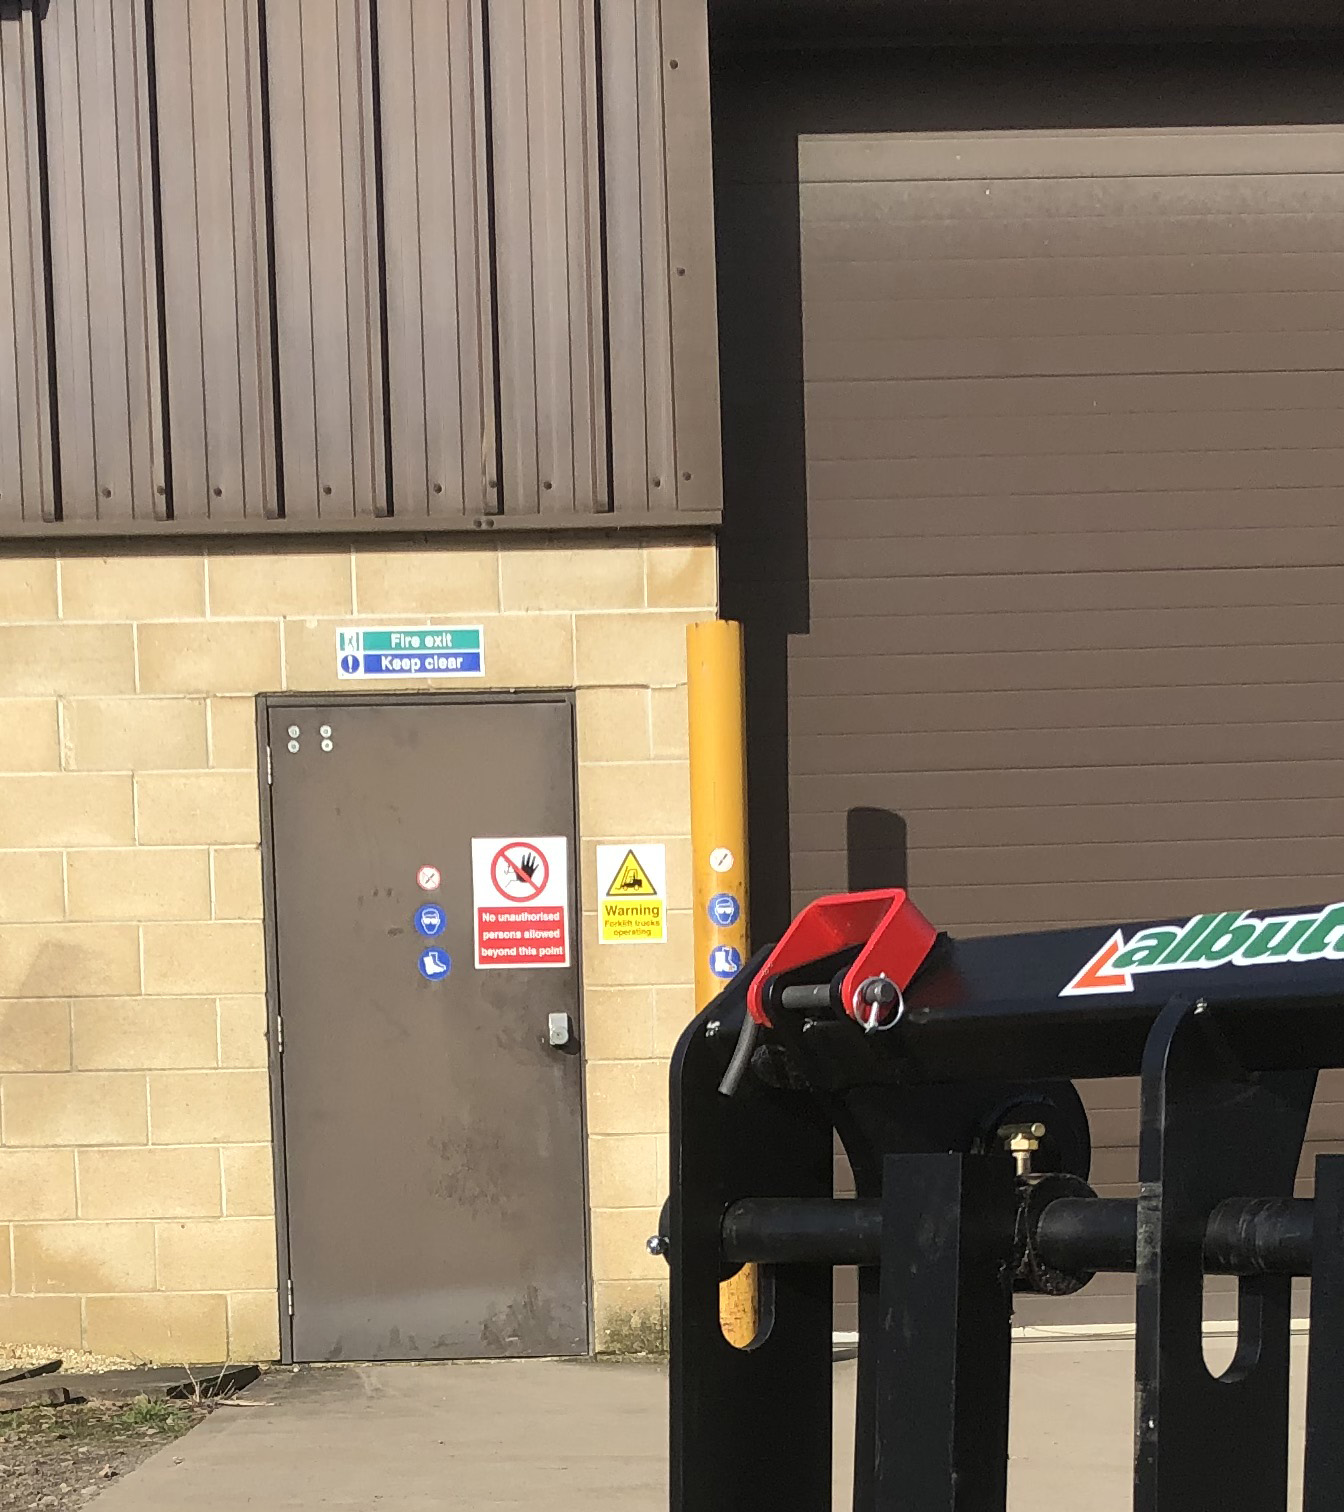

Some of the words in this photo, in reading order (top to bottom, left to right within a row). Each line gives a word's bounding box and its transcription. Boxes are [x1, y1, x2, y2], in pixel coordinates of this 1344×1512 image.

[390, 633, 420, 648] Fire
[424, 632, 452, 648] exit
[381, 655, 421, 673] Keep
[424, 654, 463, 670] clear
[482, 912, 496, 923] No
[497, 911, 560, 922] unauthorised
[604, 903, 660, 919] Warning
[482, 930, 522, 942] persons
[523, 928, 561, 939] allowed
[481, 946, 517, 958] beyond
[518, 945, 537, 956] this
[538, 945, 564, 958] point
